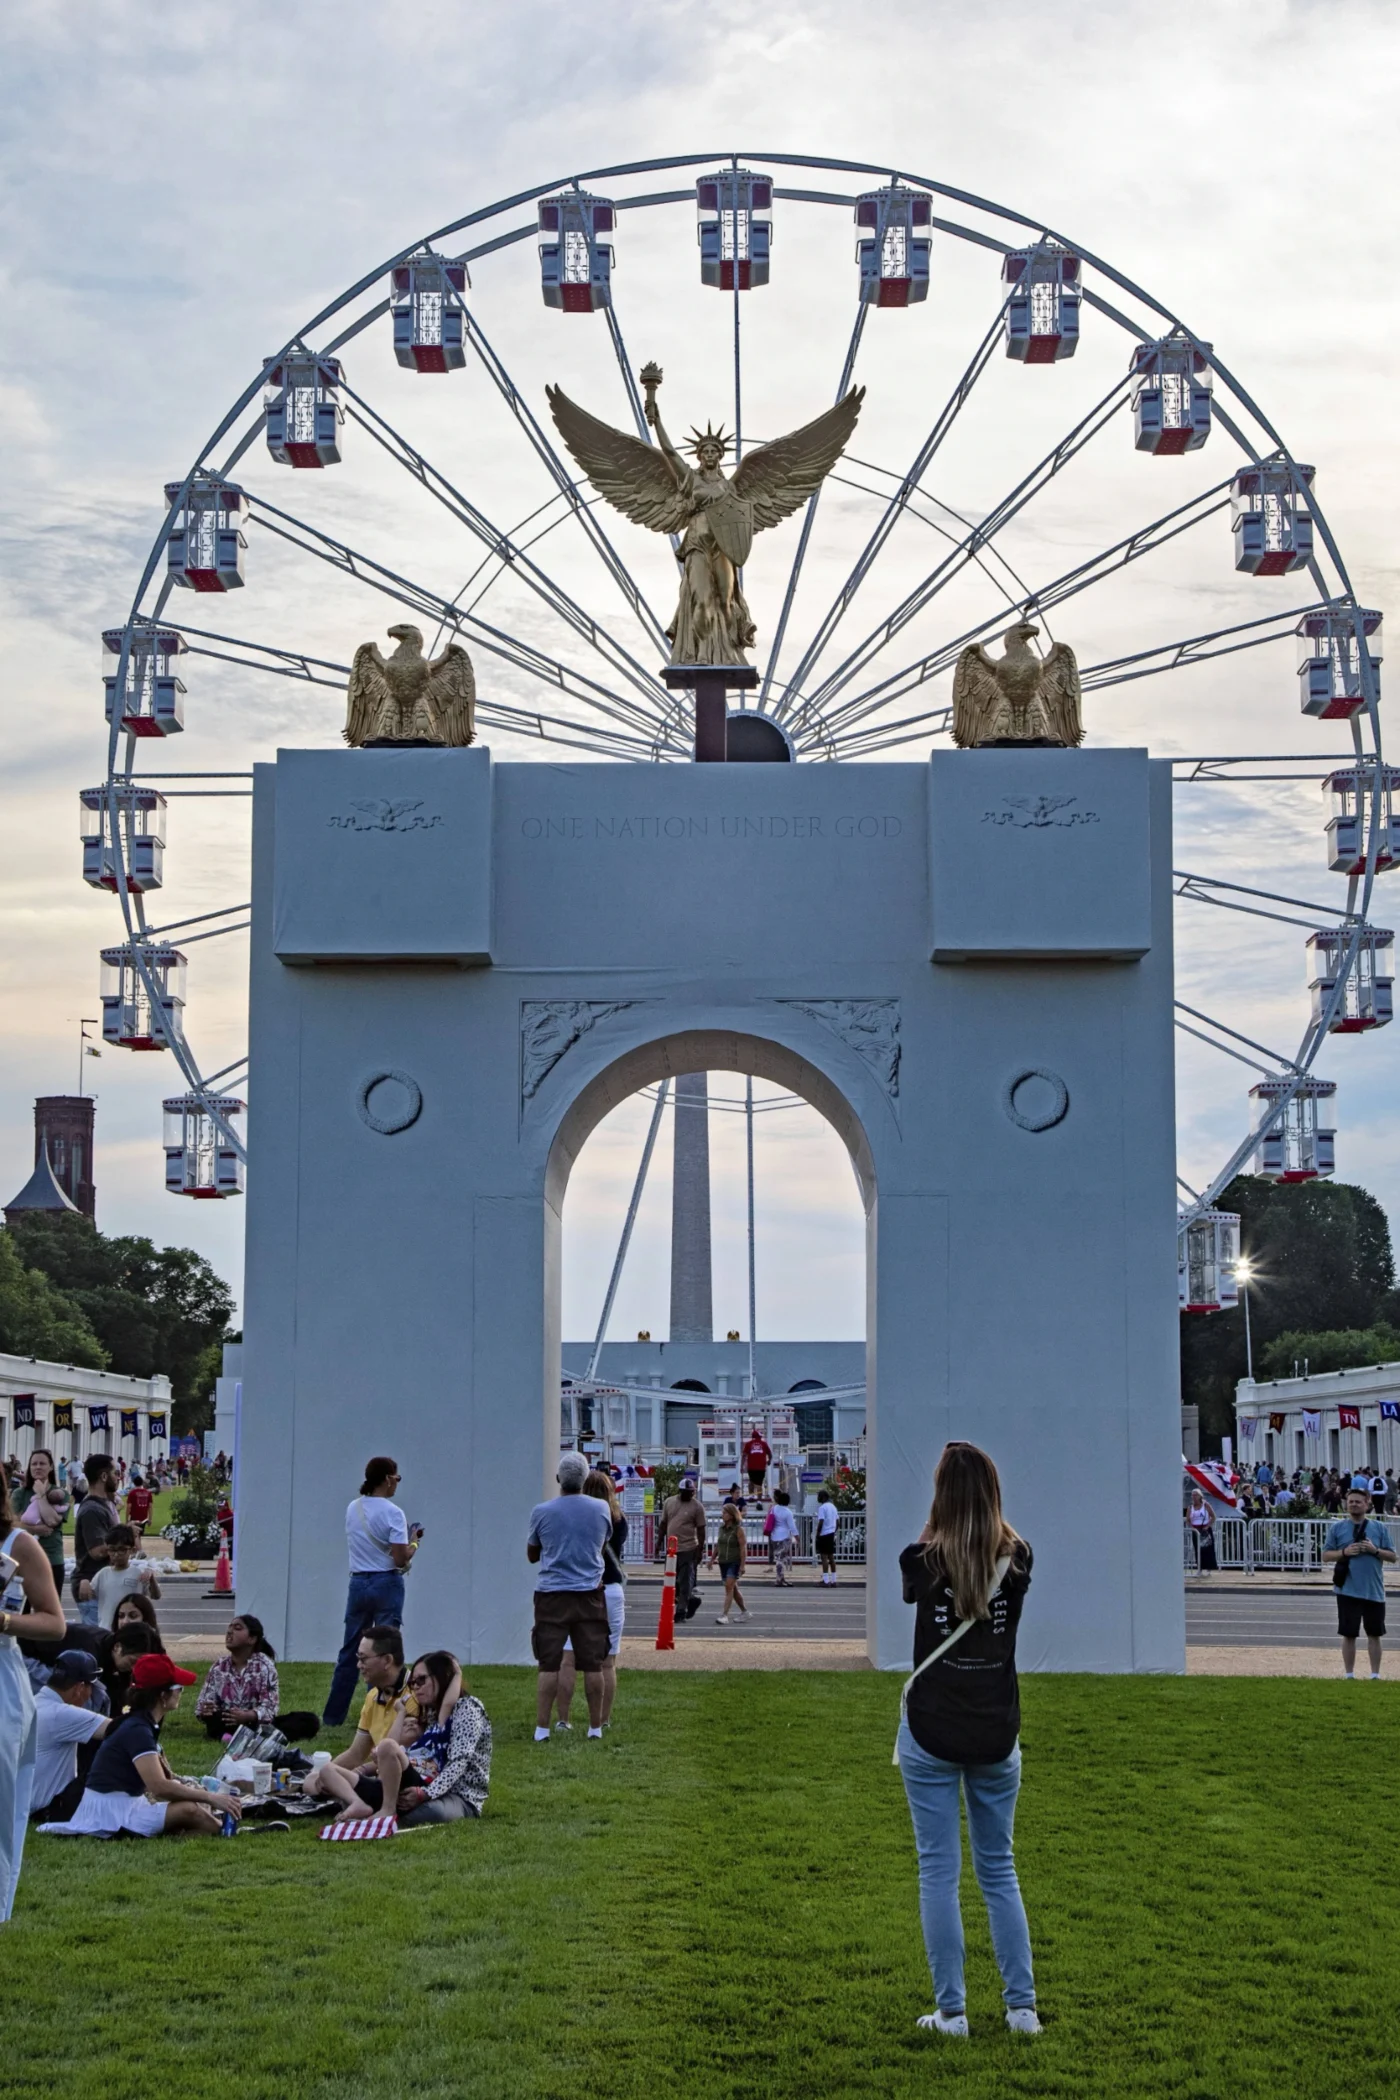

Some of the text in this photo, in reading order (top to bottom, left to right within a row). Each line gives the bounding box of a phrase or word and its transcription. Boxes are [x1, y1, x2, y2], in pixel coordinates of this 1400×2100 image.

[520, 815, 902, 840] ONE NATION UNDER GOD
[16, 1408, 33, 1423] ND
[1383, 1404, 1398, 1417] LA
[56, 1414, 70, 1427] OR
[91, 1413, 107, 1427] WY
[1343, 1413, 1358, 1425] TN
[124, 1420, 135, 1432] NE
[151, 1422, 164, 1435] CO
[1241, 1423, 1252, 1436] FL
[1306, 1420, 1318, 1433] AL
